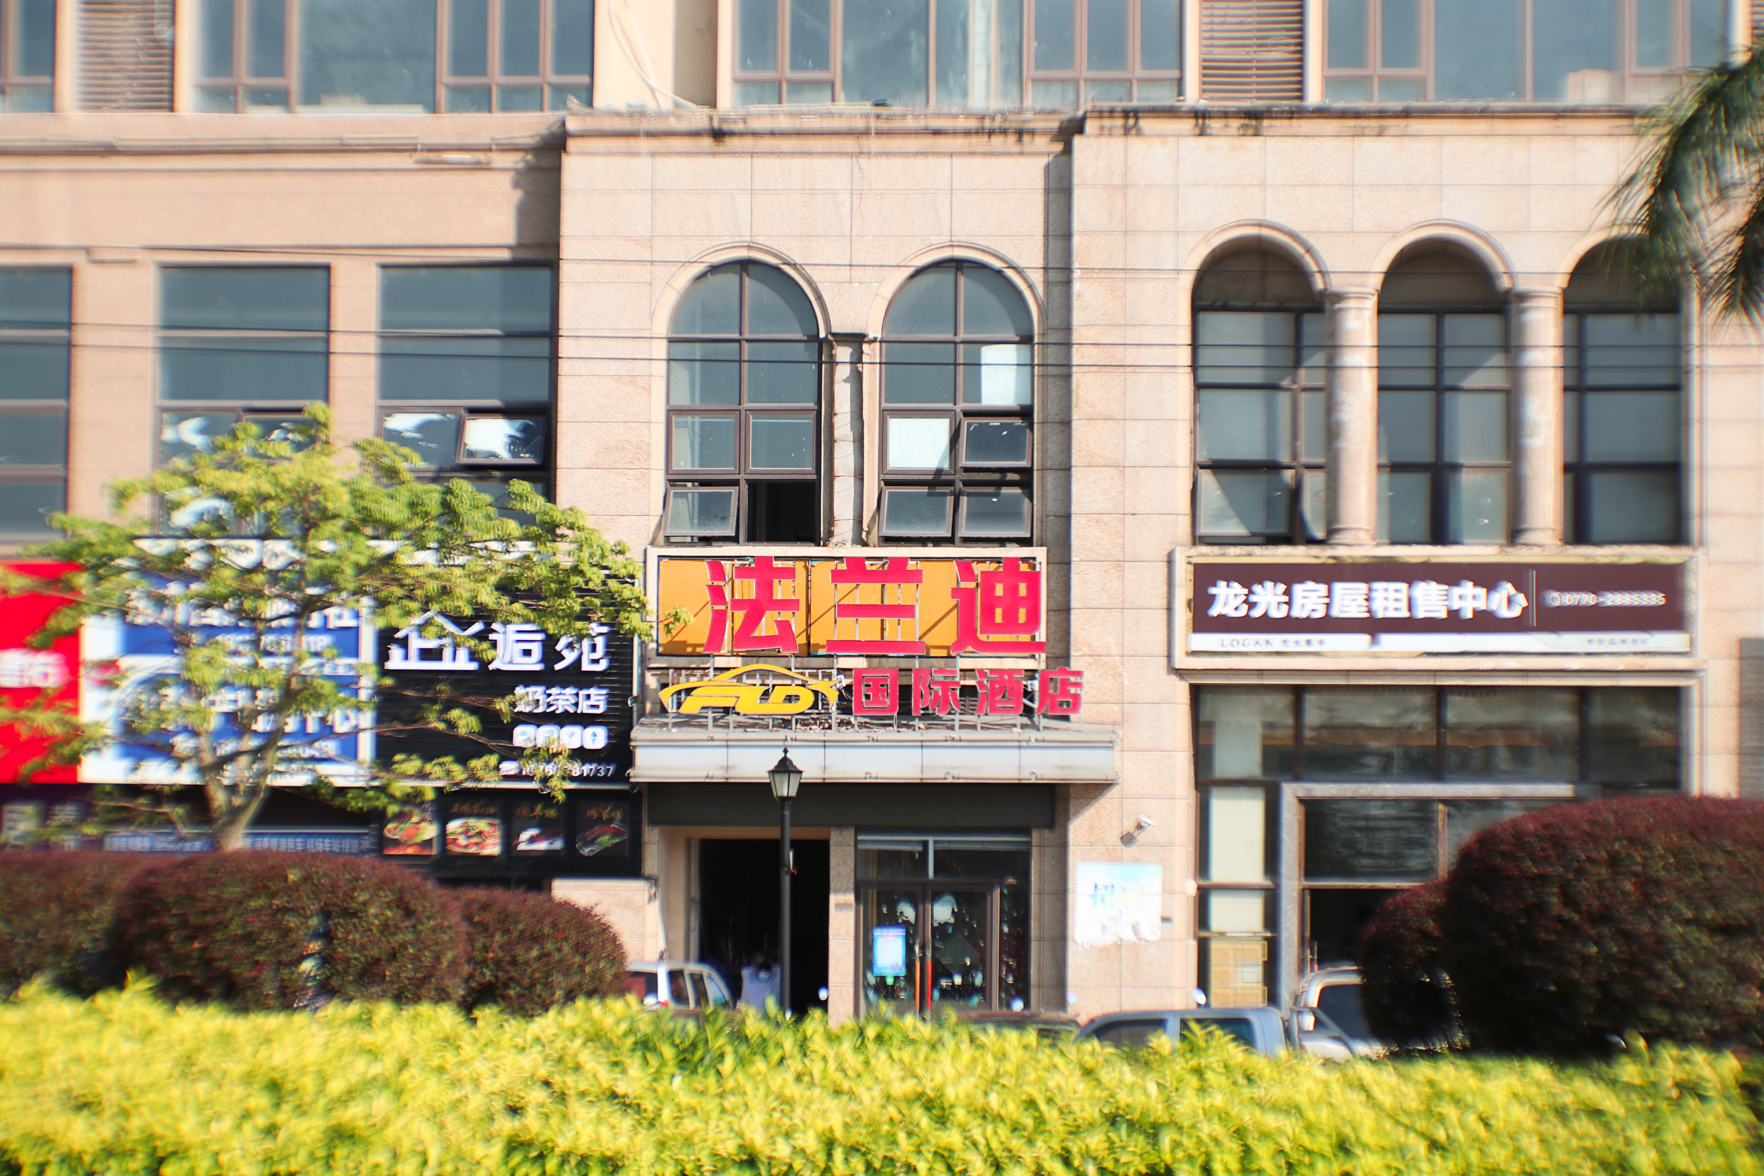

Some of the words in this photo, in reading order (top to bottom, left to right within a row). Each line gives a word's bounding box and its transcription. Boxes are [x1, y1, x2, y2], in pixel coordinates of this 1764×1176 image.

[703, 556, 1047, 655] 法兰迪
[1206, 580, 1529, 620] 龙光房屋租售中心
[1220, 637, 1275, 648] LOGAN
[513, 685, 609, 714] 奶茶店
[852, 666, 1085, 716] 国际酒店
